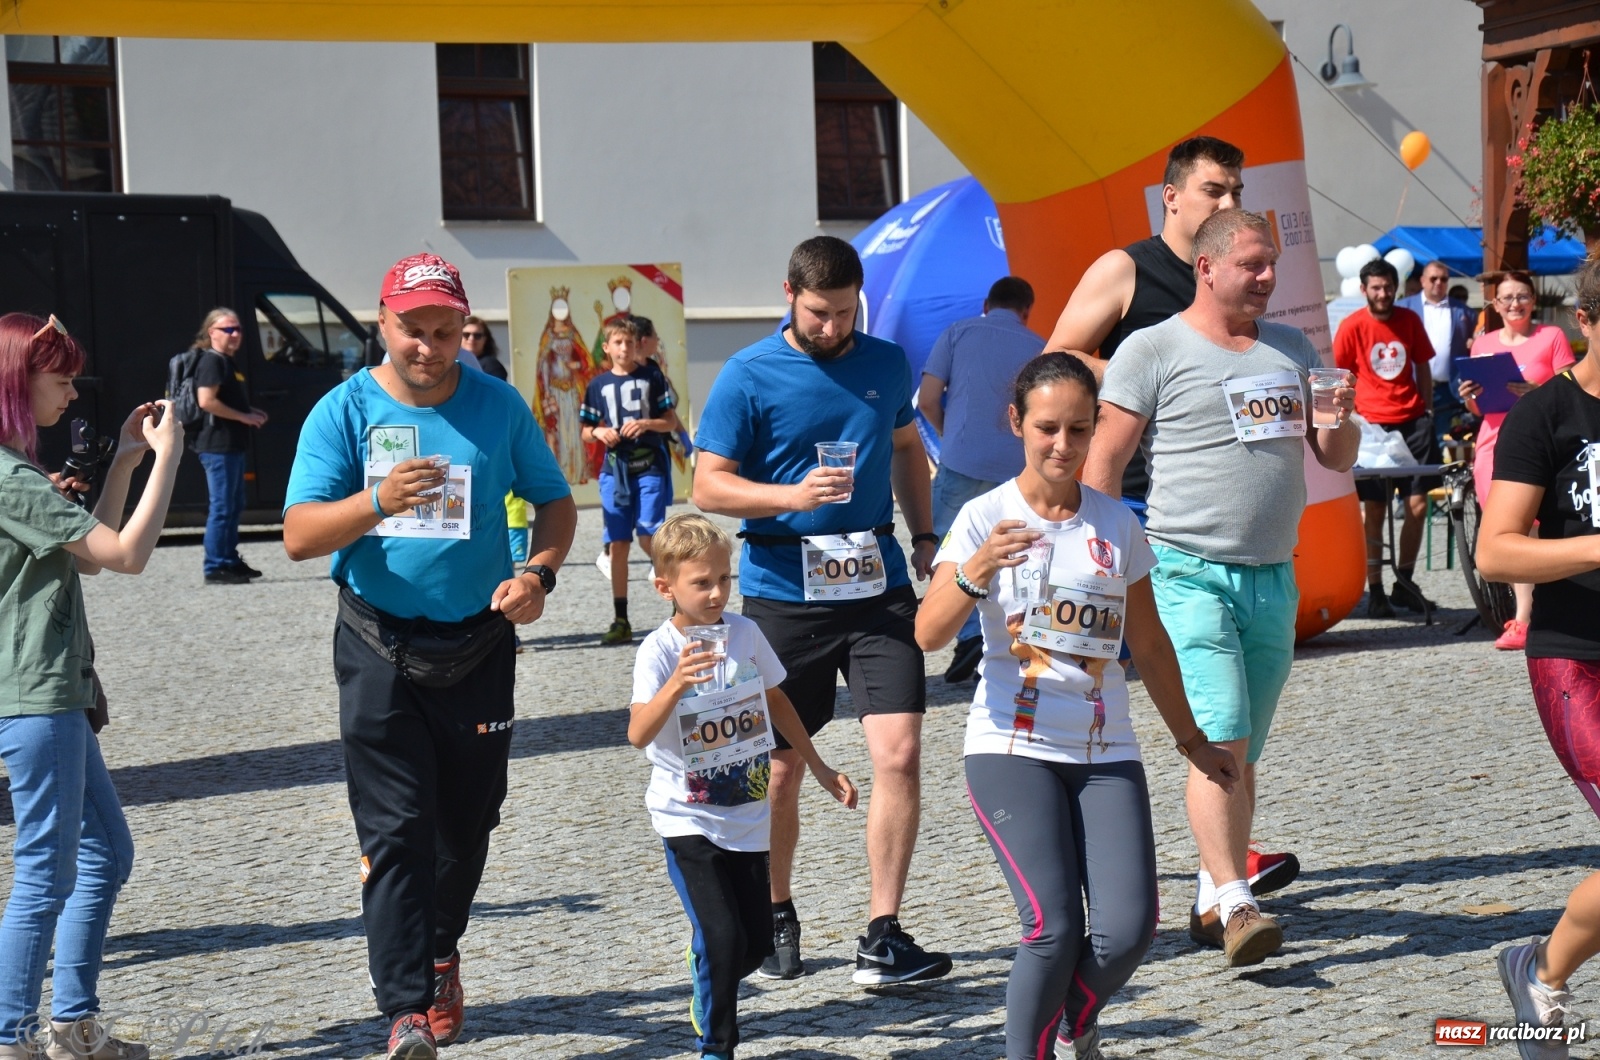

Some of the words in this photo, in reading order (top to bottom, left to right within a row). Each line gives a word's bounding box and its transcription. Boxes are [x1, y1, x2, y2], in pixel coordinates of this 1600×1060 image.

[601, 379, 650, 429] 19
[1248, 395, 1293, 418] 009
[825, 555, 874, 579] 005
[1056, 600, 1110, 632] 001
[700, 710, 753, 744] 006
